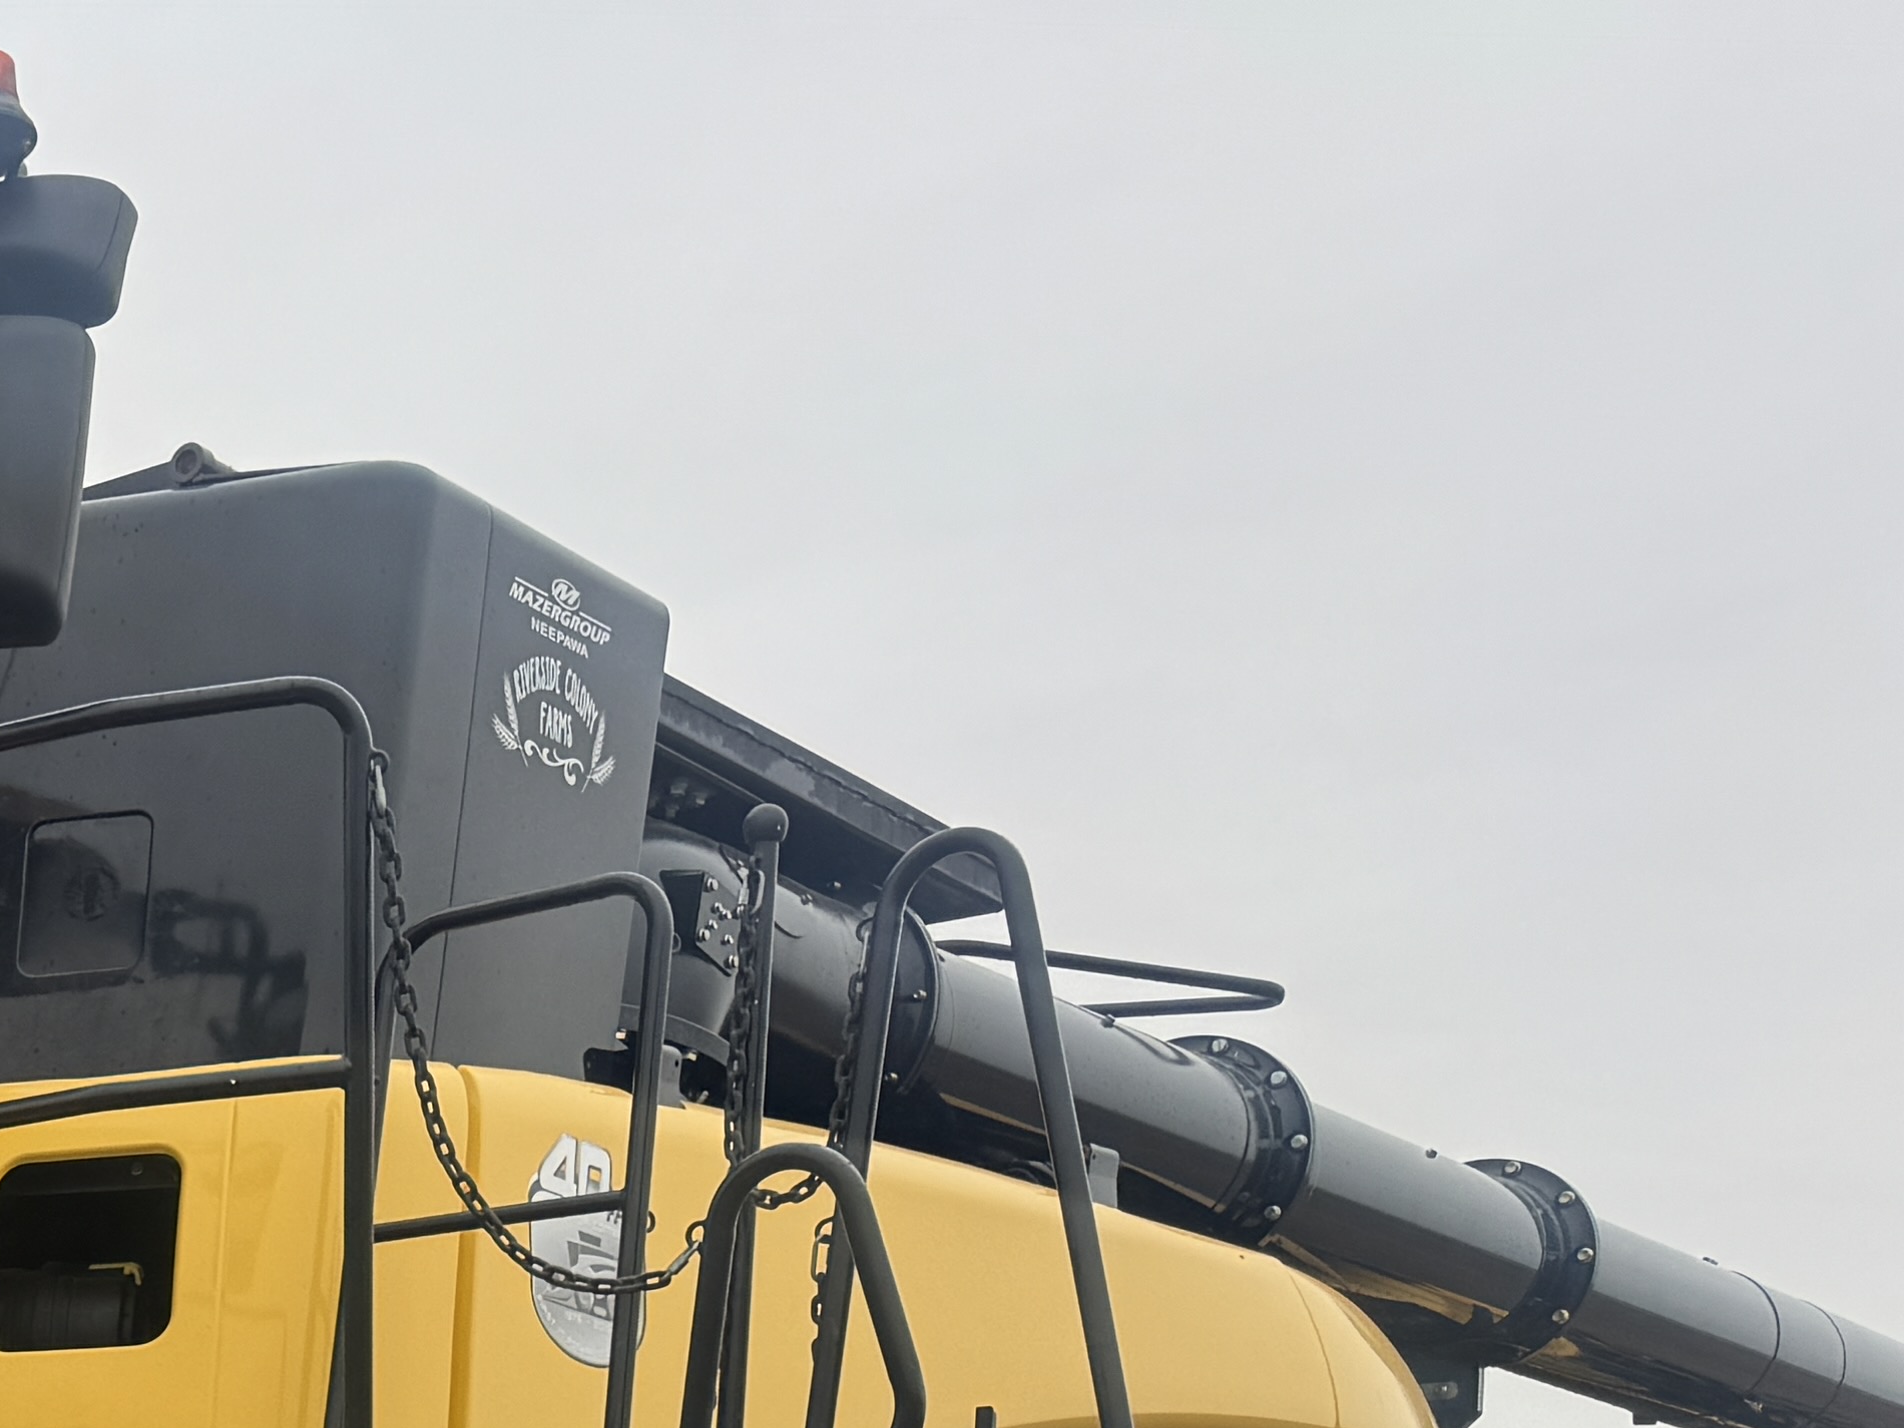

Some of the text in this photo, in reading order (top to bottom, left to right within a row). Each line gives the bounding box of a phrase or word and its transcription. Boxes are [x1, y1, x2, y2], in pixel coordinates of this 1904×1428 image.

[509, 582, 611, 646] MAZERGROUP
[530, 616, 589, 660] NEEPAWA
[513, 656, 599, 735] RIVERSIDE COLONY
[539, 701, 573, 749] FARMS
